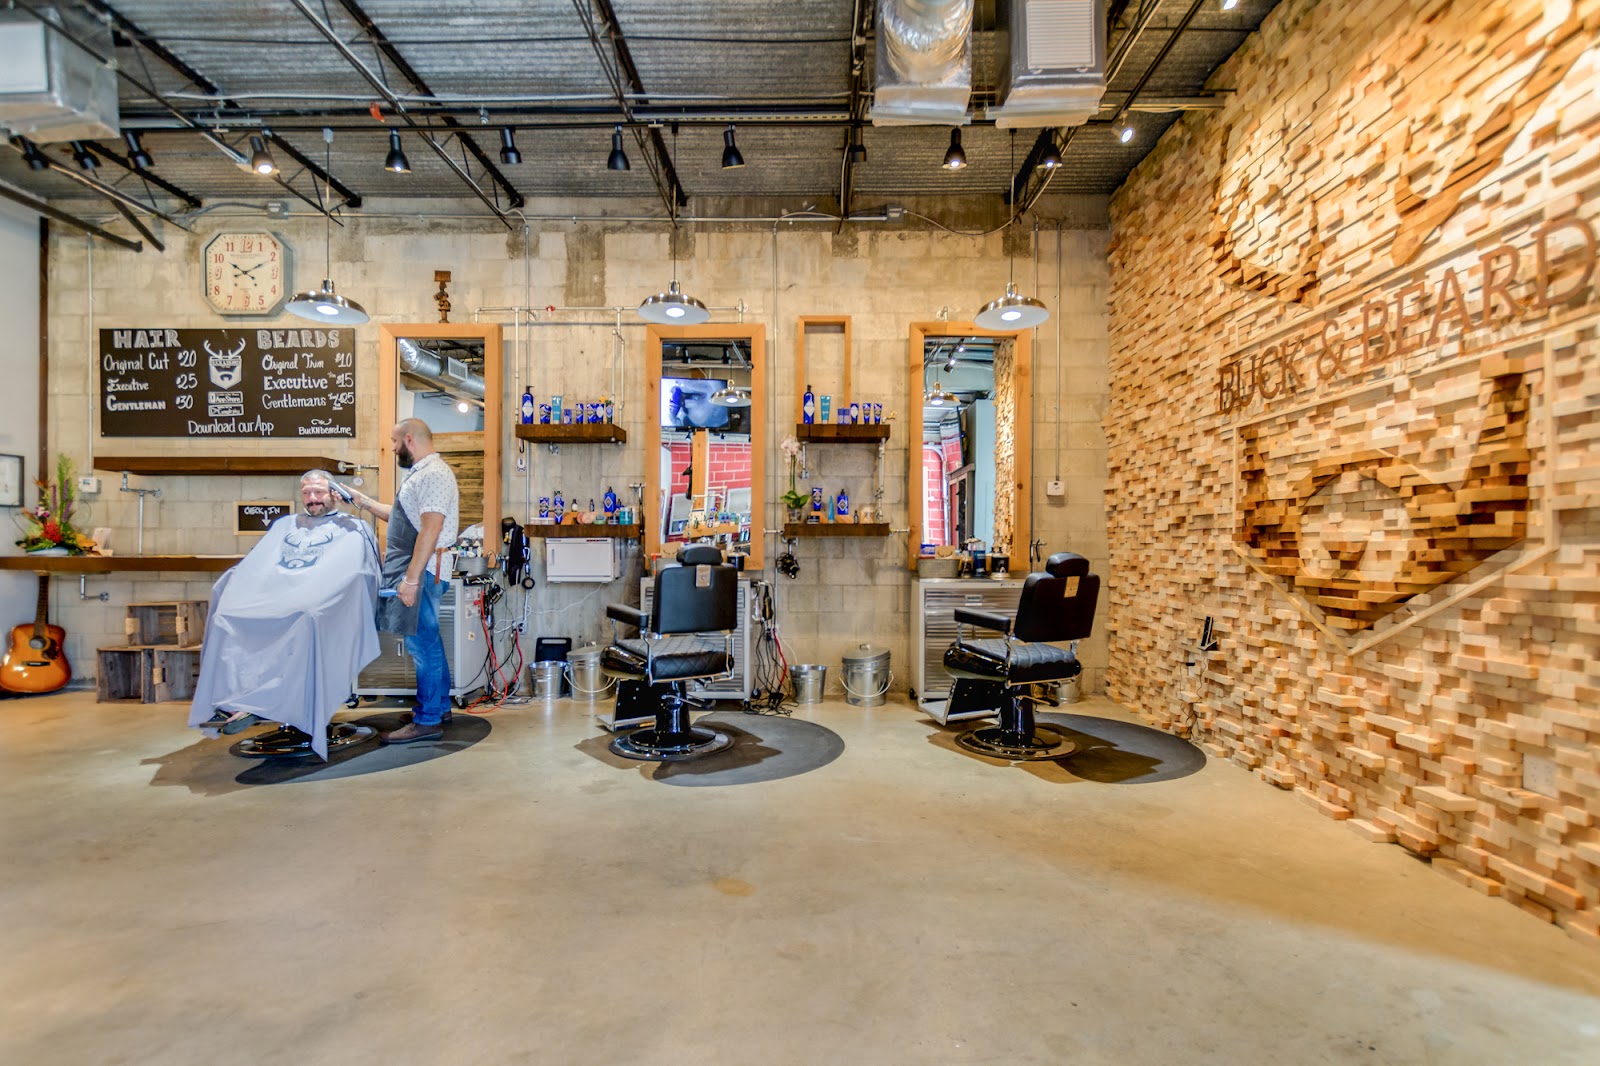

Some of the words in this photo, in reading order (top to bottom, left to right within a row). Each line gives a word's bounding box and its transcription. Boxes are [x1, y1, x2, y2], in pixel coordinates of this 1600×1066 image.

[226, 242, 234, 252] 11
[239, 239, 254, 253] 12
[259, 242, 263, 252] 1
[214, 253, 225, 263] 10
[270, 251, 277, 262] 2
[215, 266, 223, 280] 9
[271, 266, 278, 280] 3
[214, 285, 220, 296] 8
[270, 285, 277, 294] 4
[226, 295, 233, 305] 7
[243, 293, 251, 307] 6
[258, 295, 264, 305] 5
[1218, 333, 1305, 414] BUCK
[1316, 318, 1347, 381] &
[1359, 218, 1597, 369] BEARD
[113, 329, 182, 349] HAIR
[256, 329, 340, 350] BEARDS
[103, 353, 144, 375] Original
[148, 352, 170, 370] Cut
[177, 350, 197, 367] $20
[261, 353, 299, 375] Original
[301, 352, 325, 369] Trim
[334, 352, 353, 368] $10
[106, 378, 149, 392] Executive
[175, 373, 198, 390] $25
[263, 373, 329, 391] Executive
[336, 372, 354, 388] $15
[175, 394, 194, 410] $30
[262, 393, 327, 410] Gentlemans
[187, 417, 236, 434] Download
[238, 422, 255, 433] our
[254, 414, 275, 436] App
[244, 506, 265, 515] CHECK
[267, 506, 281, 515] IN
